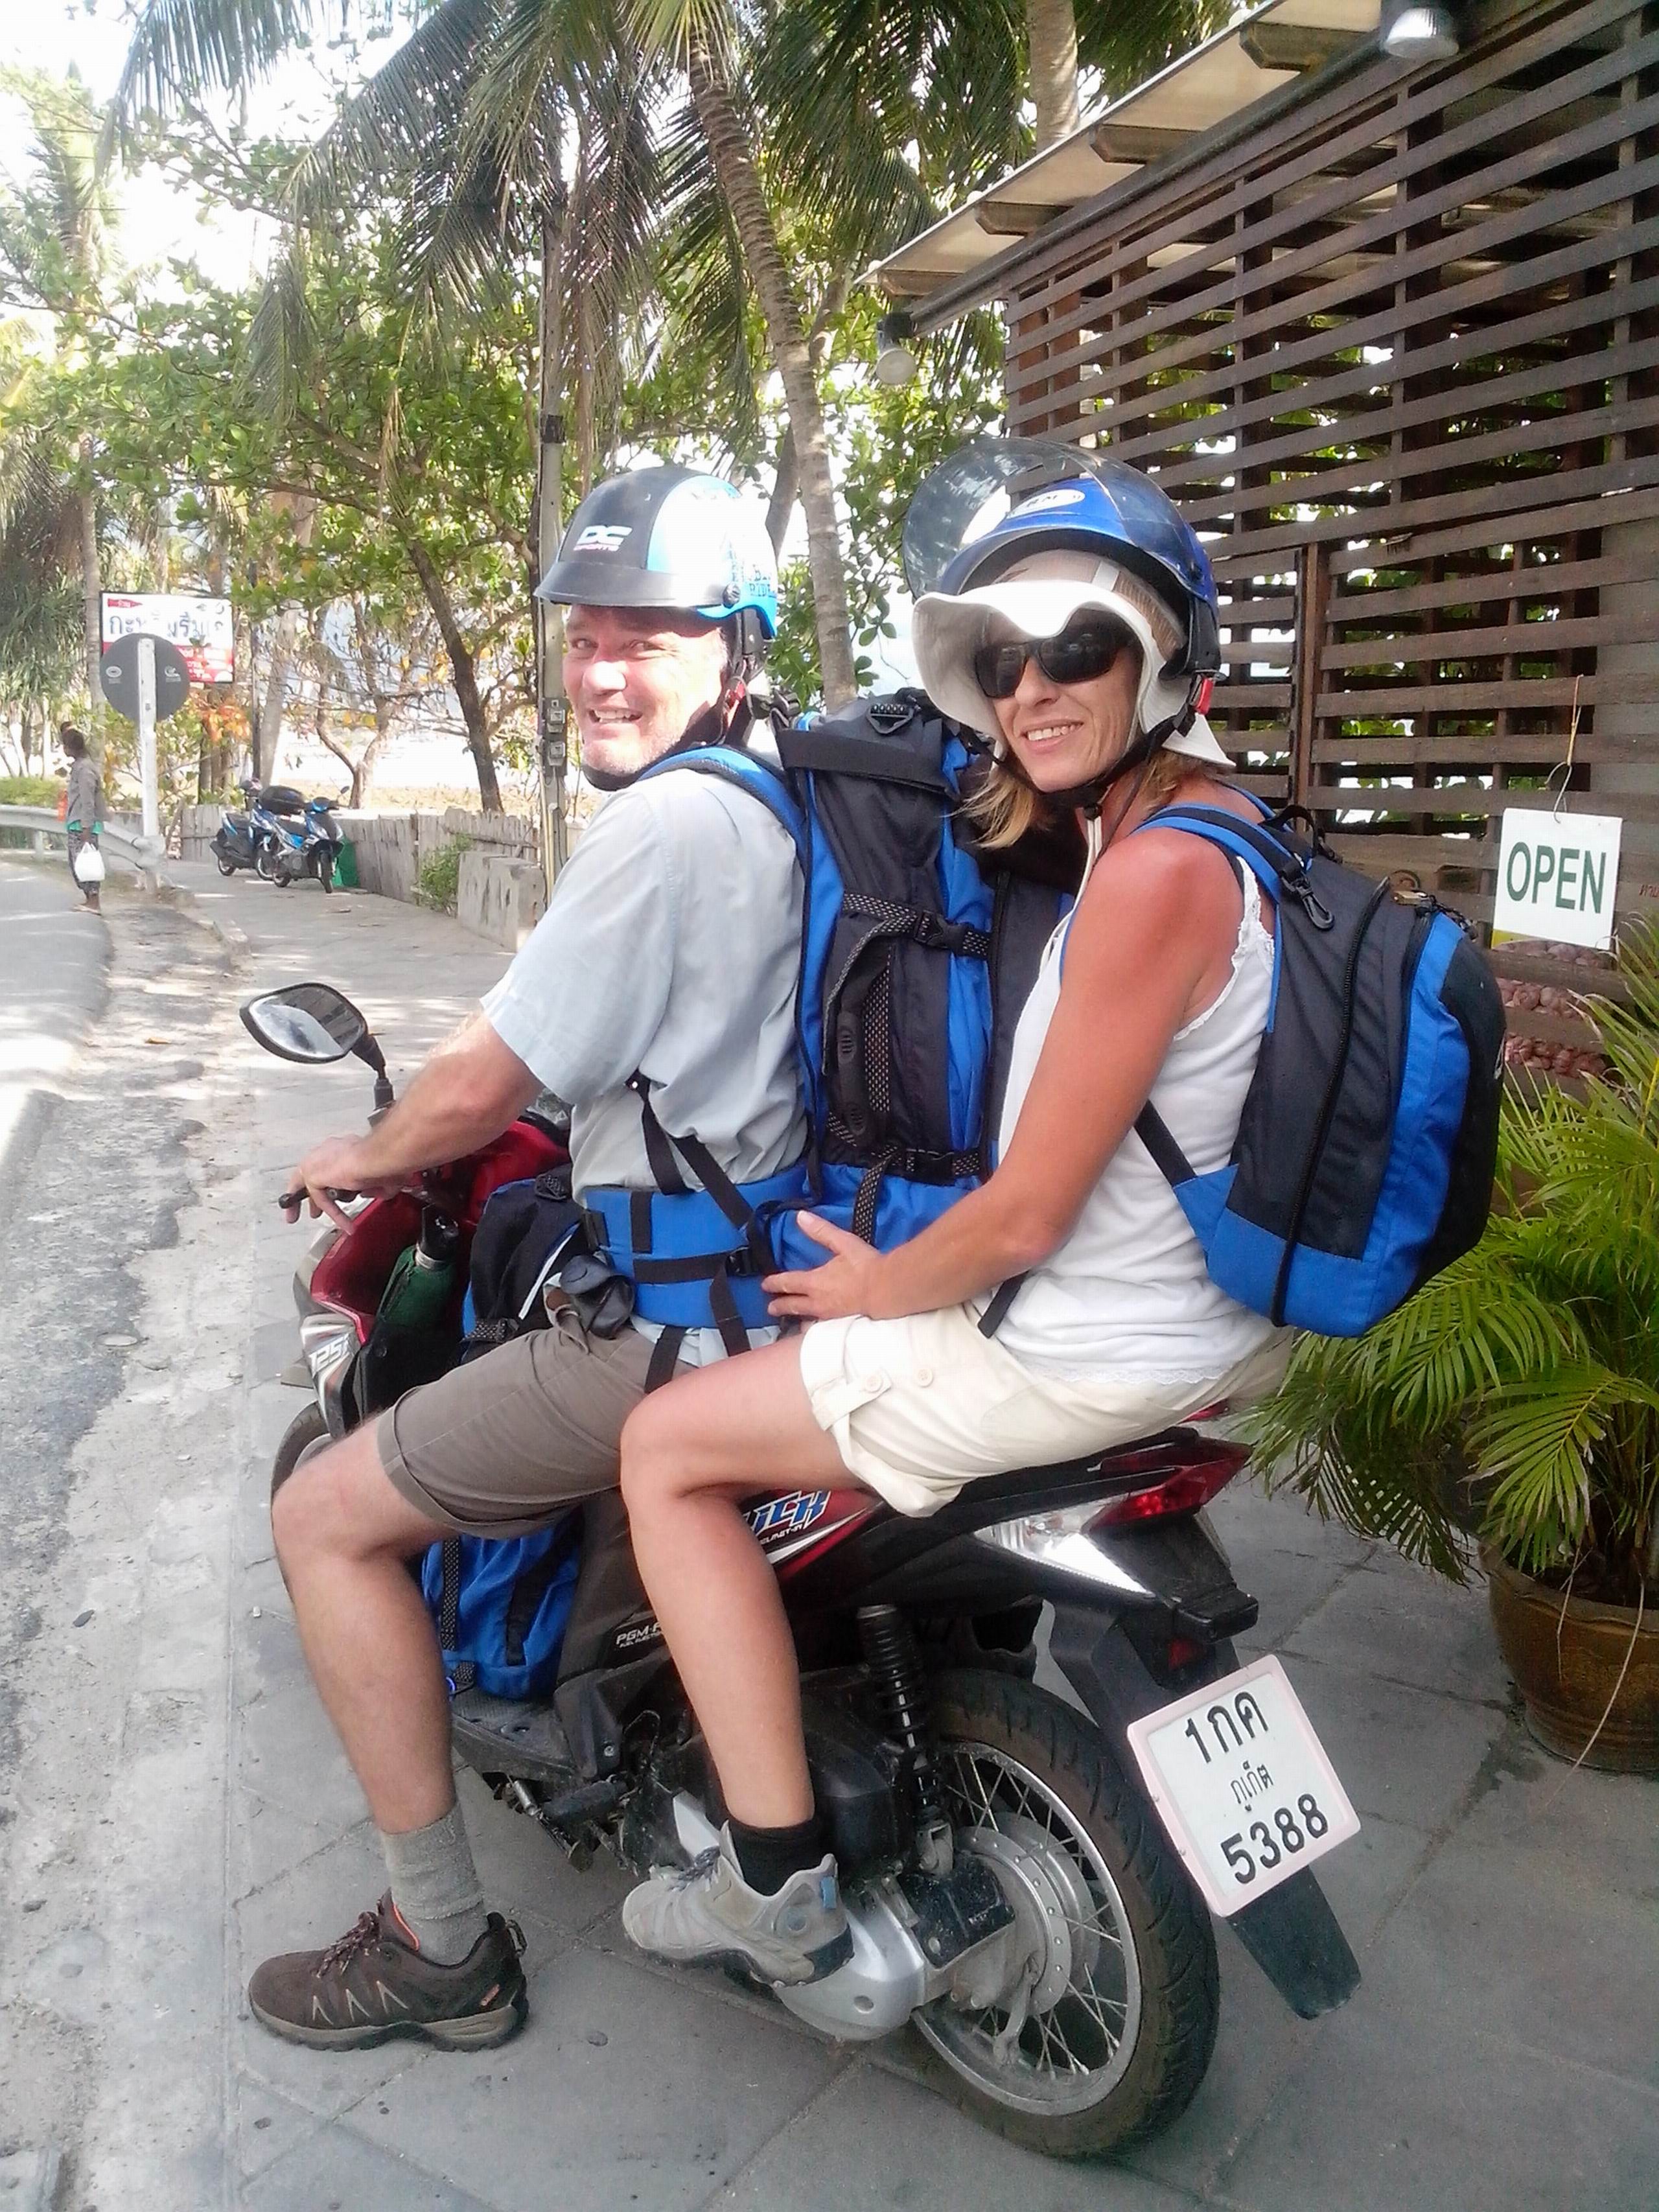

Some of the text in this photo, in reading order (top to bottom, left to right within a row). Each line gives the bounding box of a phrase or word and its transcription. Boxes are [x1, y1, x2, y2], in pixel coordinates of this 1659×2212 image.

[1507, 842, 1607, 914] OPEN
[616, 1622, 660, 1645] PGM-F
[1185, 1692, 1269, 1764] 1กค
[1230, 1760, 1274, 1812] ภูเก็ต
[1221, 1793, 1328, 1885] 5388
